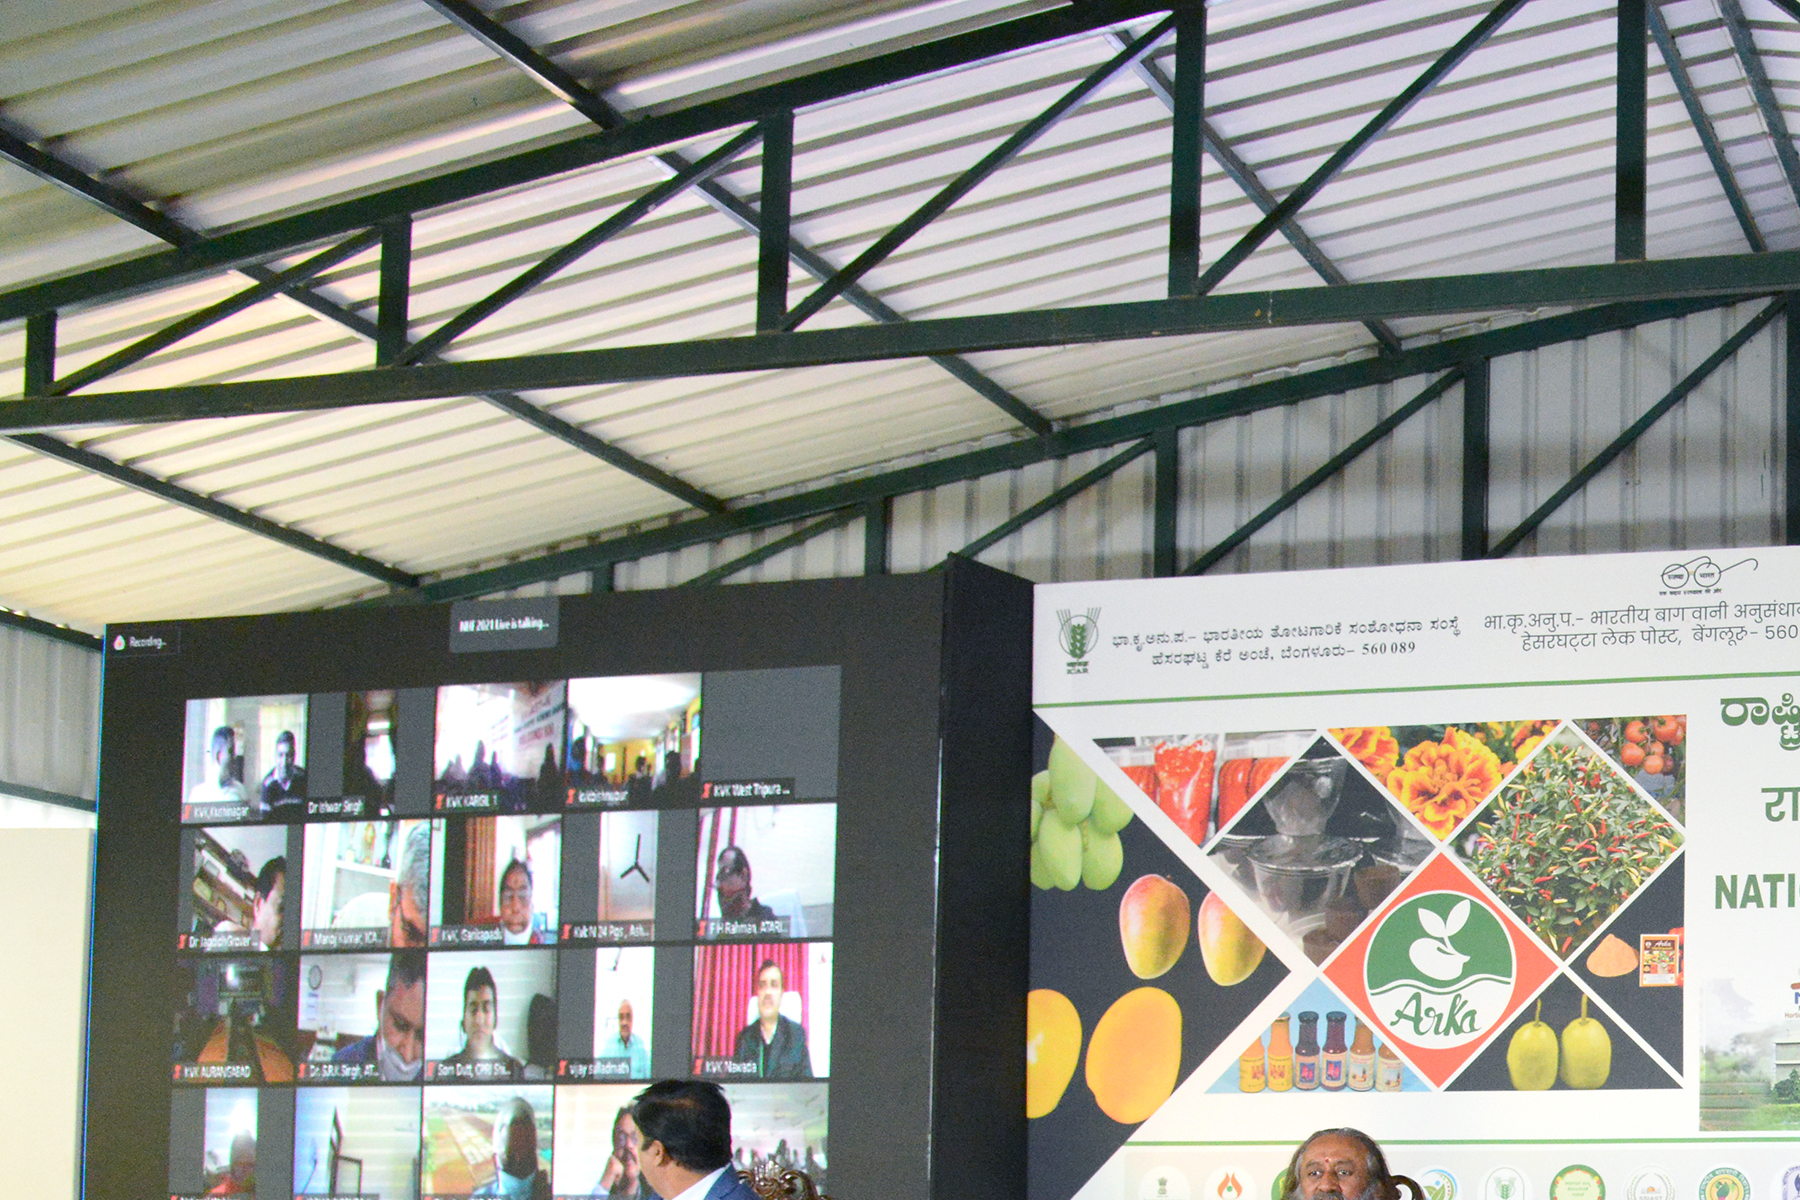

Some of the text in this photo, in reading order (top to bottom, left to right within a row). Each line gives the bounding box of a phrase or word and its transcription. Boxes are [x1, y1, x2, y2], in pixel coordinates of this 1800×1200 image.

[1590, 606, 1650, 626] भारतीय
[1203, 628, 1264, 644] ಭಾರತೀಯ
[1270, 623, 1343, 640] ತೋಟಗಾರಿಕೆ
[1349, 618, 1423, 636] ಸಂಶೋಧನಾ
[1429, 615, 1462, 638] ಸಂಸ್ಥೆ
[1602, 627, 1635, 647] लेक
[1764, 624, 1799, 641] 560
[1361, 642, 1387, 656] 560
[1389, 640, 1416, 654] 089
[731, 783, 753, 797] West
[753, 782, 781, 800] Tripura
[1390, 991, 1482, 1037] Arka
